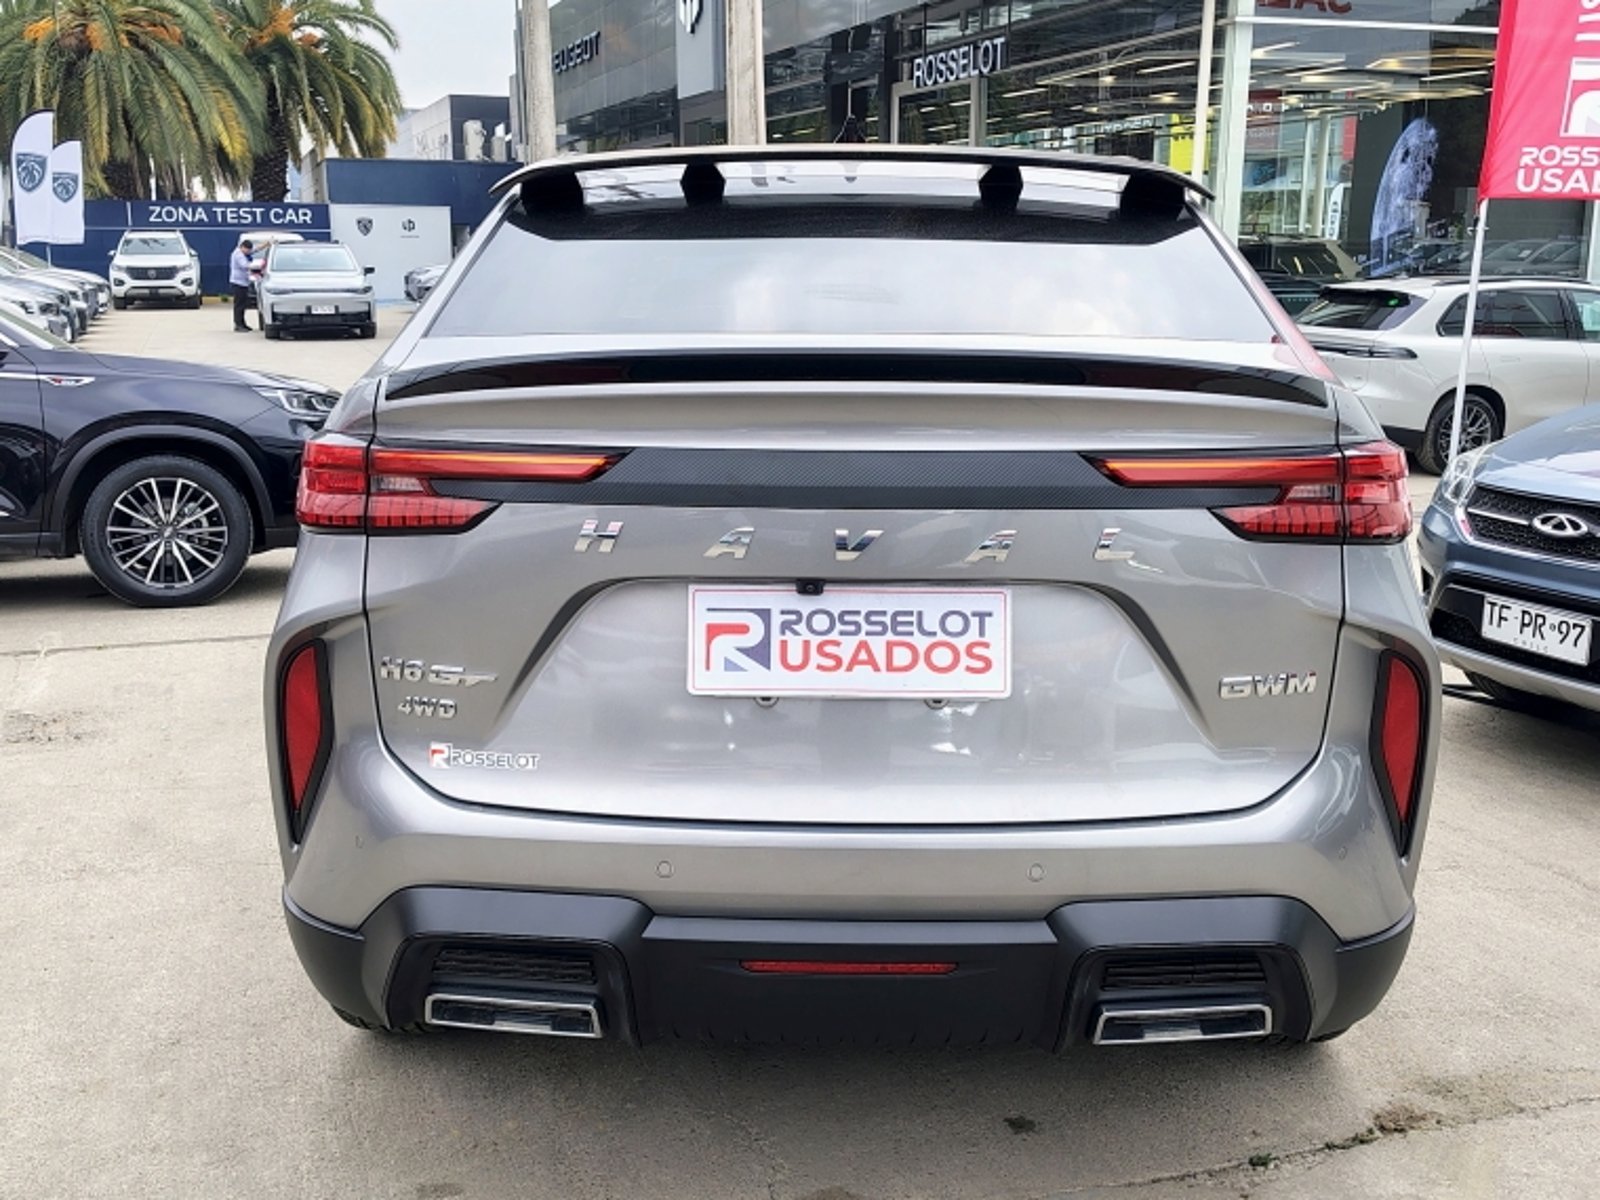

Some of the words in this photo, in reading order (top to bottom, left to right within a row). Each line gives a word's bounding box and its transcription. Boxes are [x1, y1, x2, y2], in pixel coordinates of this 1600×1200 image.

[552, 31, 600, 75] EUGEOT
[913, 36, 1006, 89] ROSSELOT
[149, 206, 208, 222] ZONA
[213, 207, 265, 224] TEST
[269, 208, 312, 224] CAR
[574, 519, 1135, 562] HAVAL
[779, 608, 993, 637] ROSSELOT
[380, 656, 424, 682] H6
[779, 639, 993, 674] USADOS
[1219, 671, 1317, 699] GWM
[398, 696, 457, 718] 4WD
[452, 752, 540, 769] ROSSELOT
